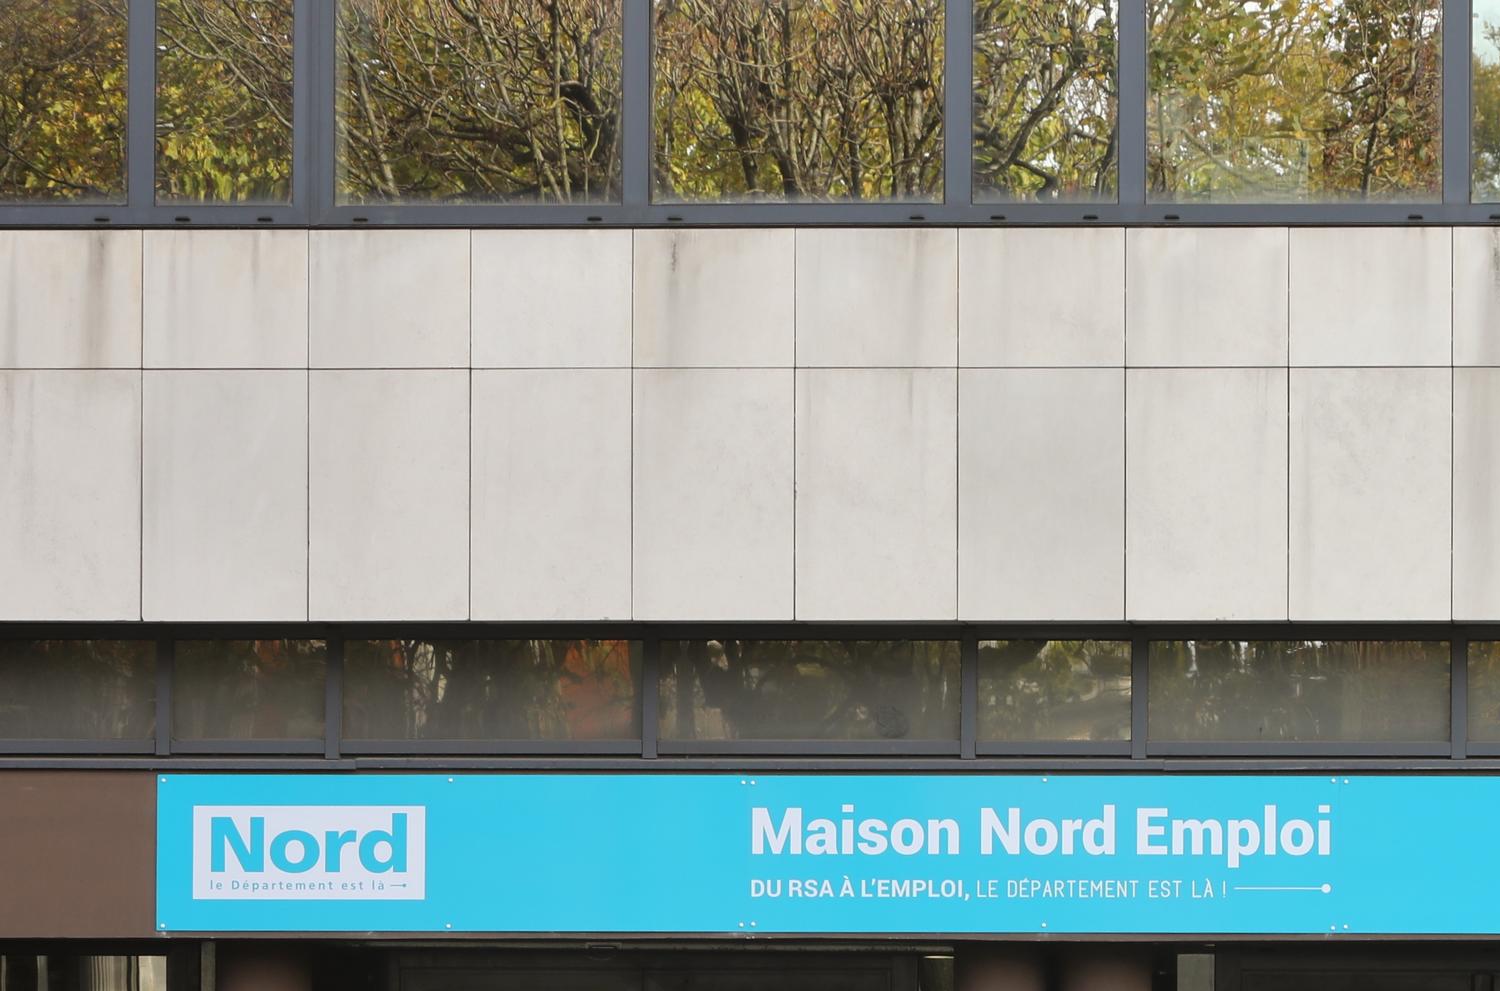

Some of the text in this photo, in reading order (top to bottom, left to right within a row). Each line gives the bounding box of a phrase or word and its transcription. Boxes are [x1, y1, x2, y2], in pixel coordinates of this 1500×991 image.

[210, 812, 408, 874] Nord
[751, 803, 1331, 869] Maison Nord Emploi
[210, 878, 385, 893] le Département est là
[750, 879, 782, 898] DU
[788, 879, 835, 898] RSA
[839, 875, 855, 898] À
[976, 879, 999, 898] LE
[1007, 876, 1139, 898] DÉPARTEMENT
[1148, 879, 1183, 898] EST
[1191, 876, 1214, 899] LÀ
